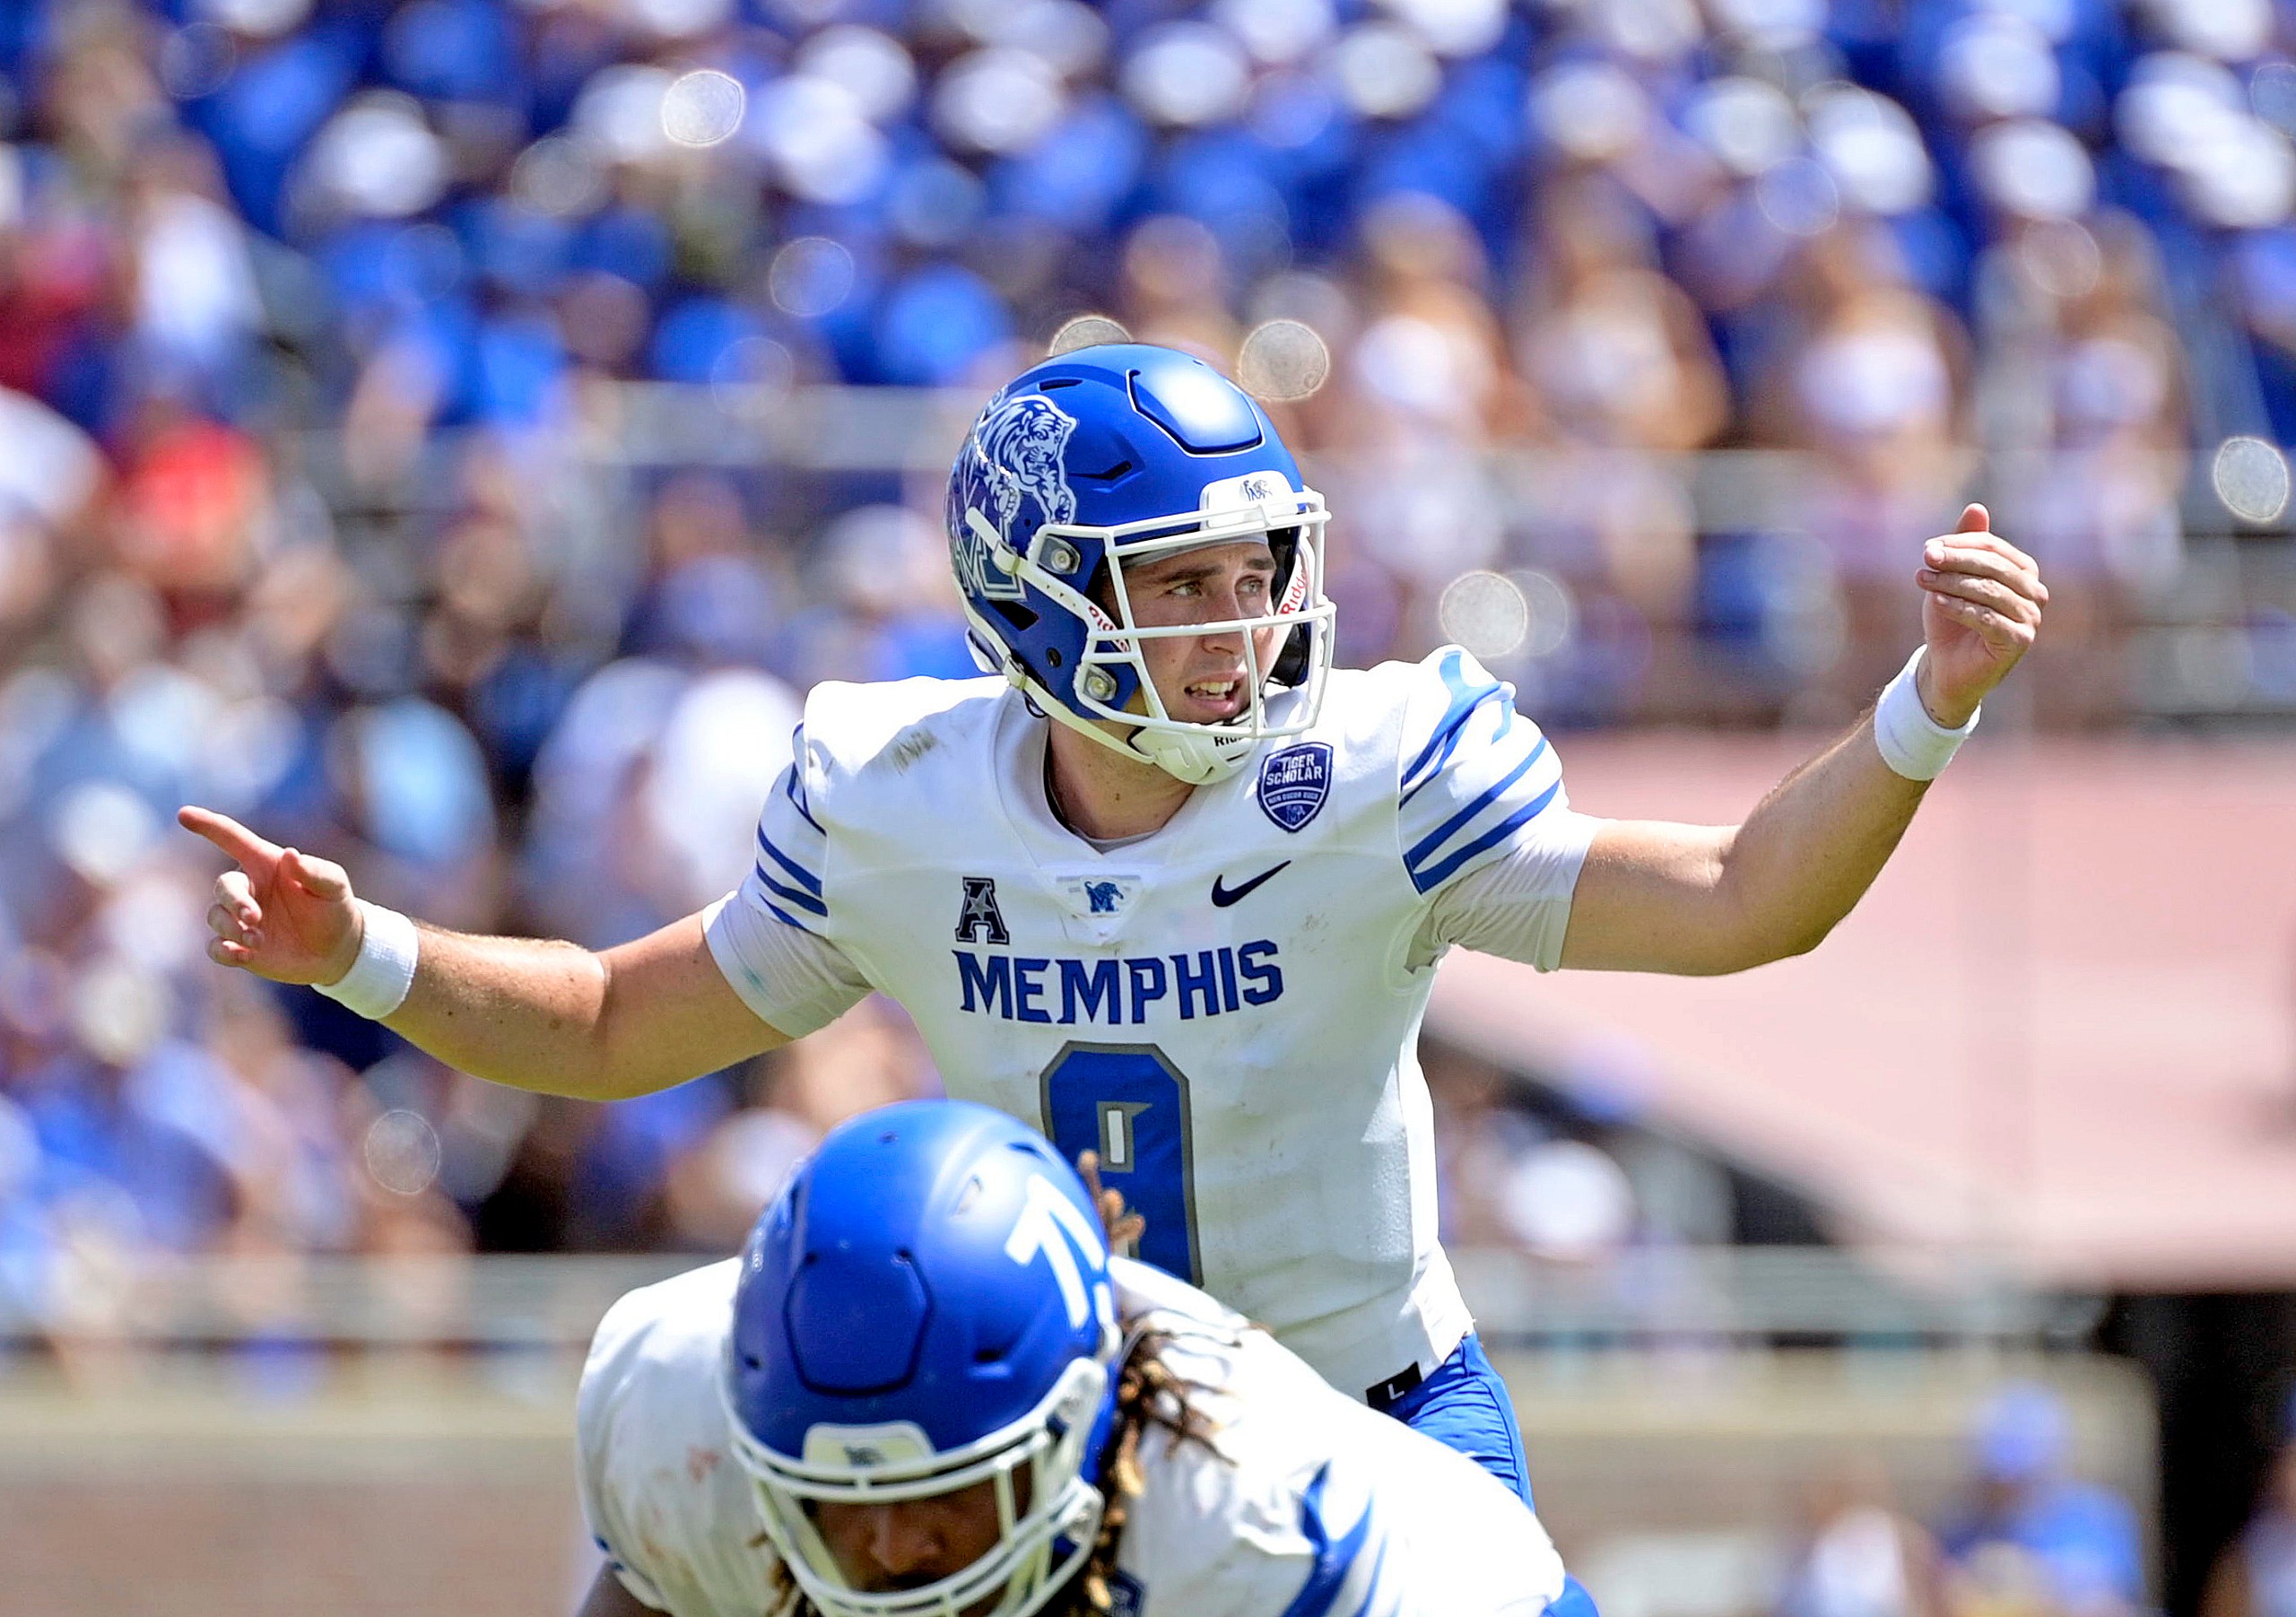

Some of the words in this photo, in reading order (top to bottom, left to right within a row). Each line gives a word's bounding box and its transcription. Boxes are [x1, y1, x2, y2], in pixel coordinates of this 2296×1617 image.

[1265, 765, 1323, 786] SCHOLAR
[1277, 753, 1316, 771] TIGER
[955, 876, 1010, 945] A
[951, 939, 1284, 1025] MEMPHIS
[1039, 1040, 1205, 1290] 9
[1387, 1383, 1405, 1400] L
